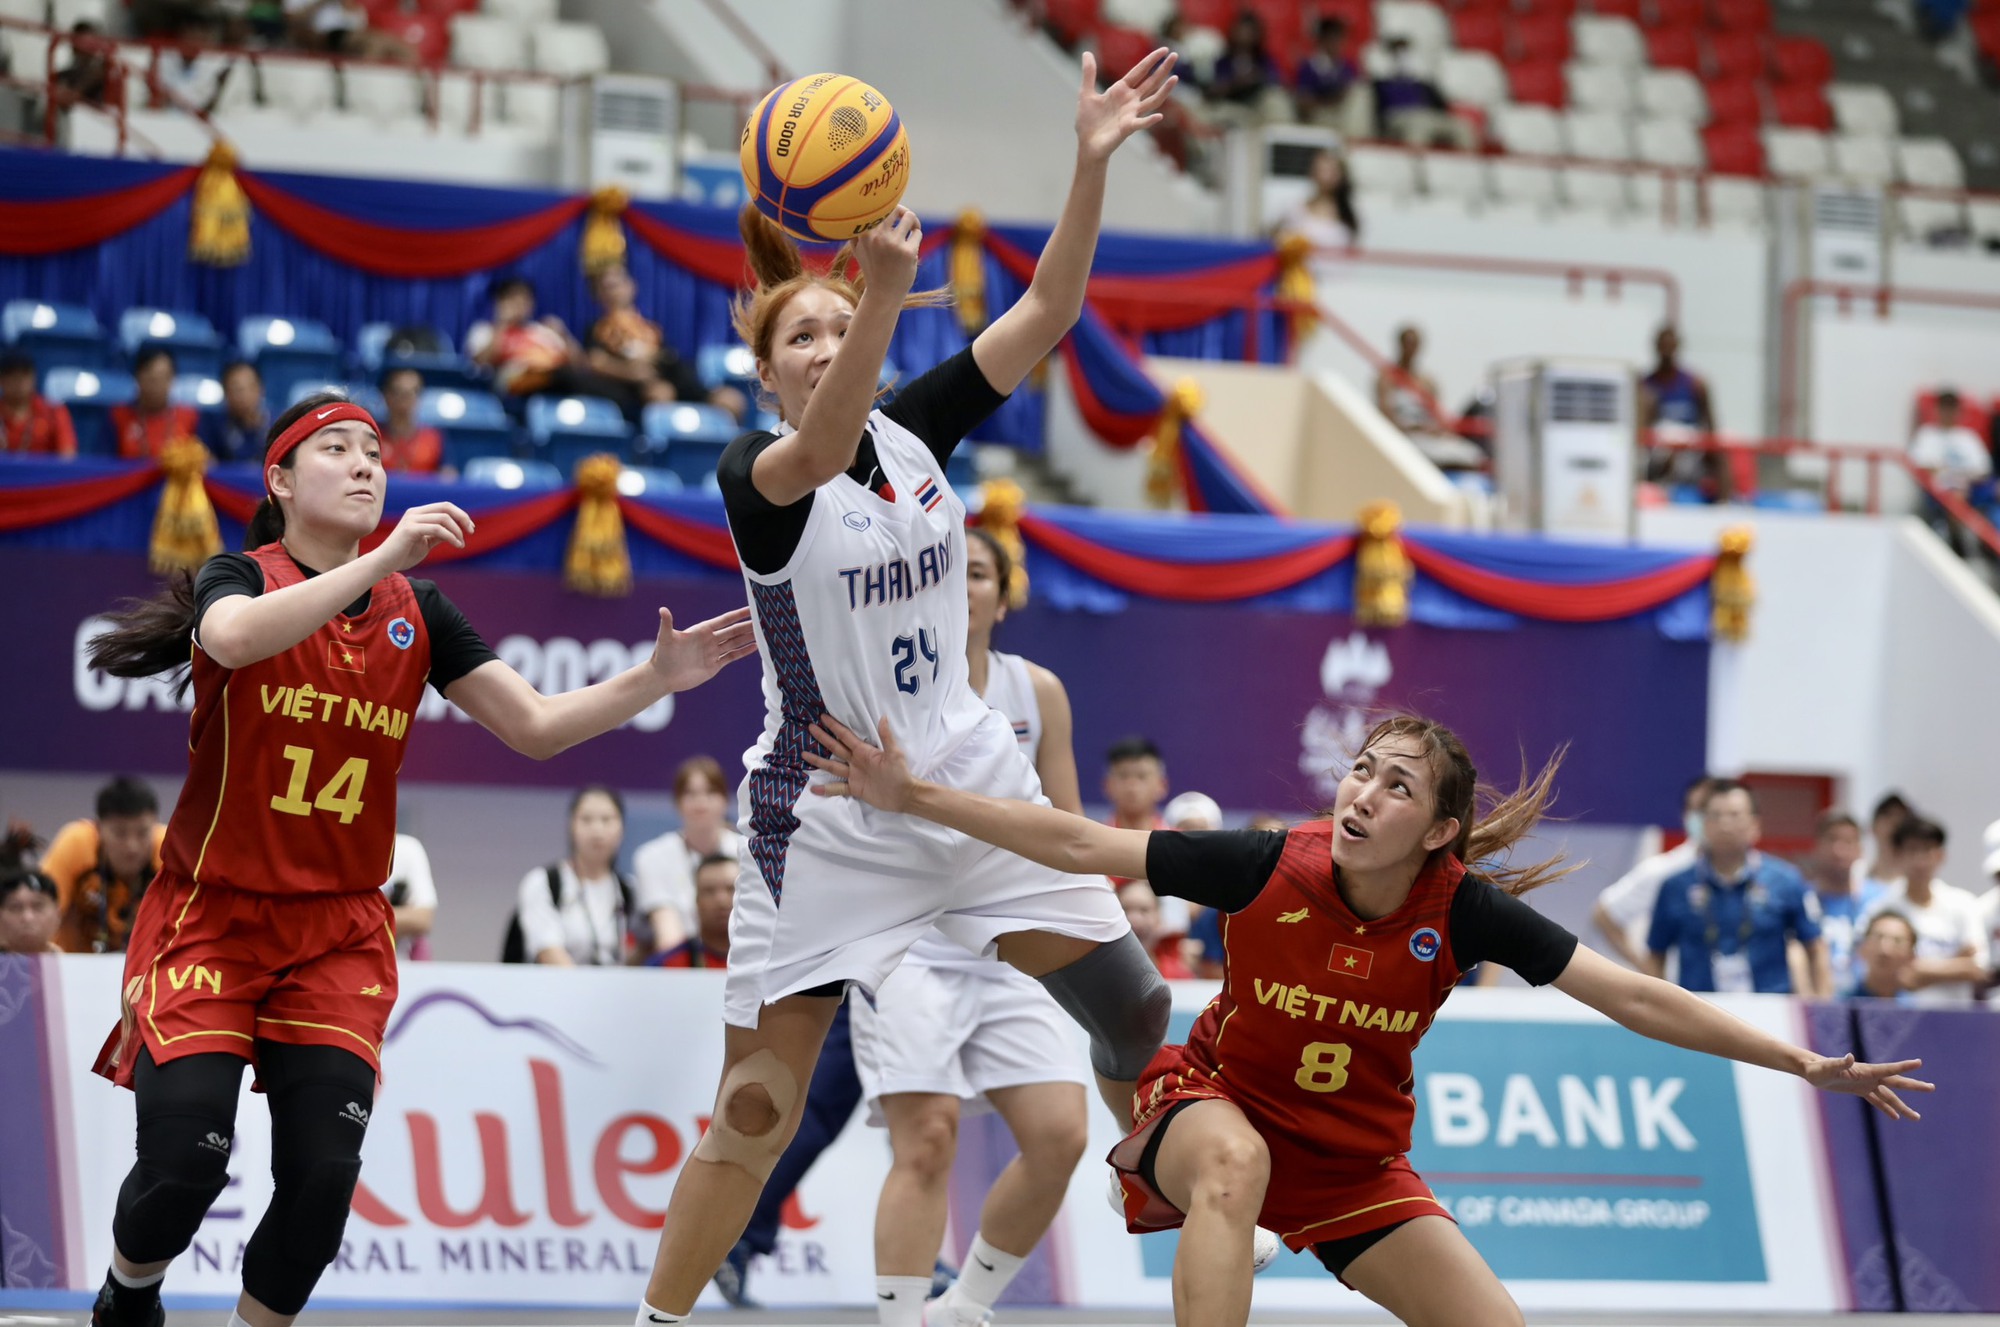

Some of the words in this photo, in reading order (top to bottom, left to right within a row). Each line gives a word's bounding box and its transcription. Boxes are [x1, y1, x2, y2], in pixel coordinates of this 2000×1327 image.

[788, 96, 810, 119] FOR
[776, 121, 797, 158] GOOD
[838, 529, 953, 612] THAIAN
[891, 624, 940, 696] 24
[261, 683, 342, 723] VIỆT
[344, 698, 408, 740] NAM
[270, 744, 369, 824] 14
[168, 964, 222, 995] VN
[1254, 978, 1337, 1021] VIỆT
[1338, 1000, 1419, 1033] NAM
[1294, 1041, 1352, 1092] 8
[1425, 1072, 1699, 1151] BANK
[1456, 1195, 1496, 1227] OF
[1502, 1195, 1612, 1228] CANADA
[1613, 1198, 1711, 1229] GROUP
[439, 1238, 650, 1275] MINERAL
